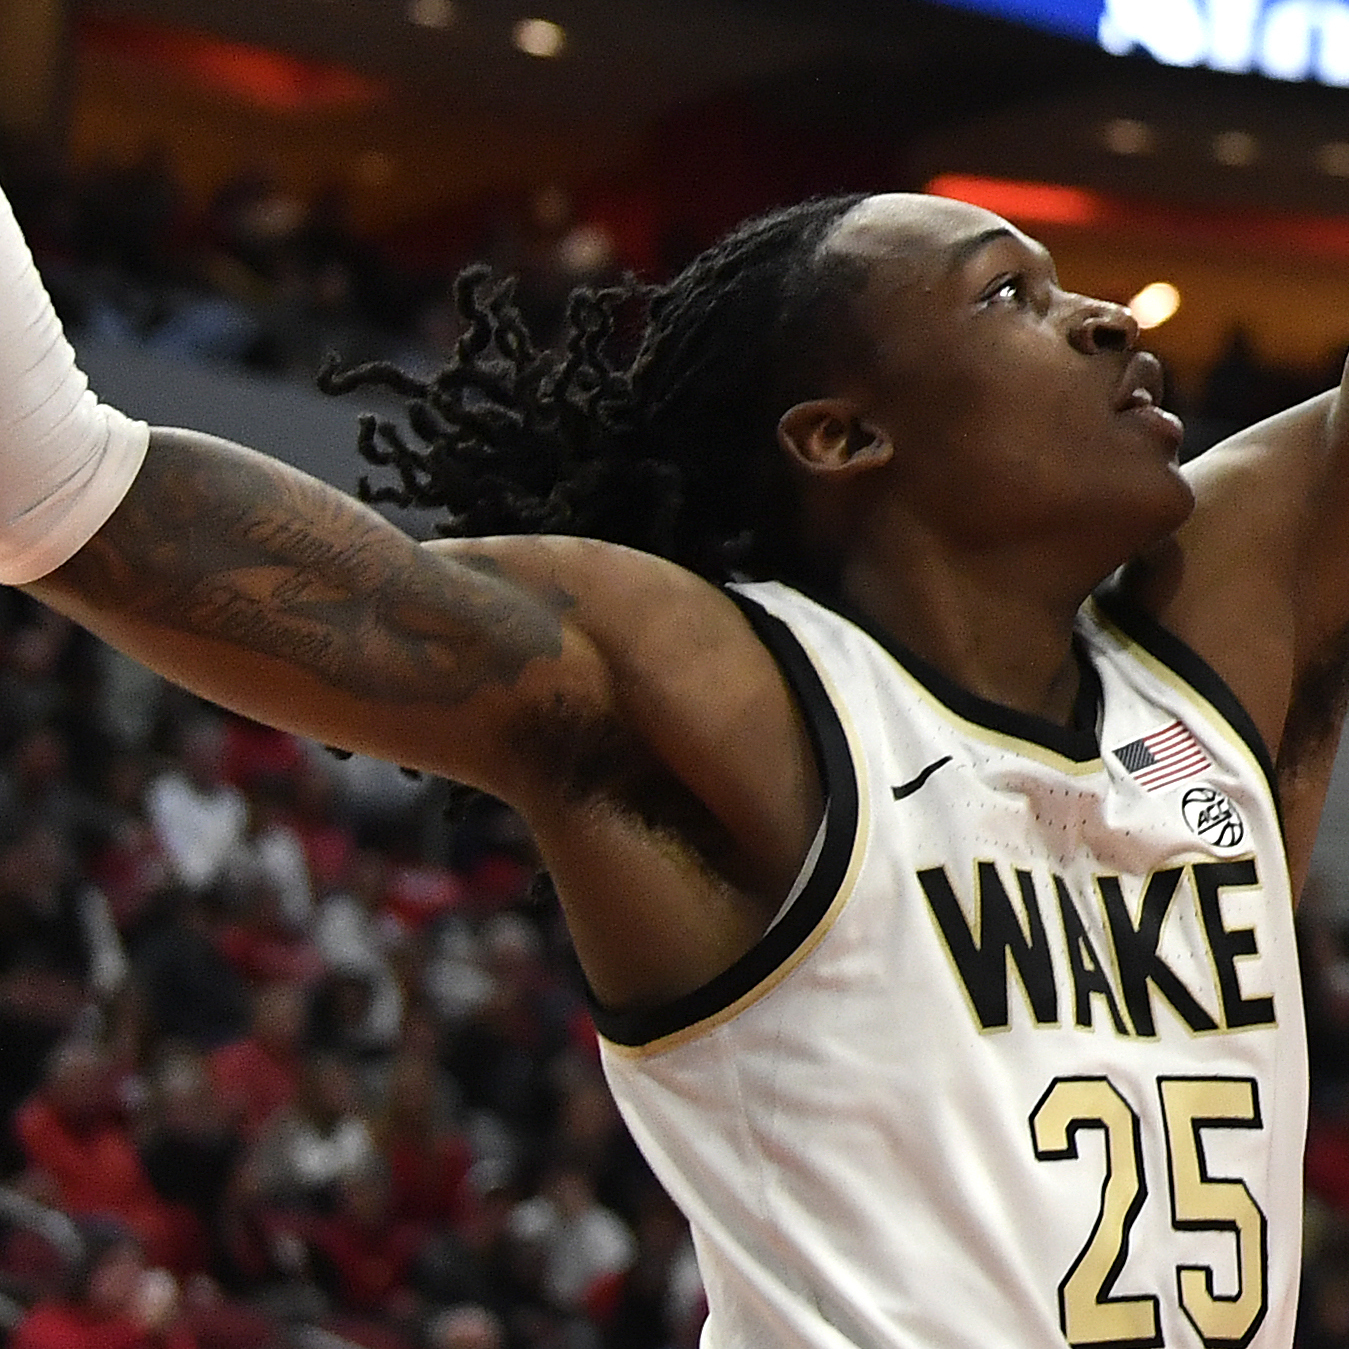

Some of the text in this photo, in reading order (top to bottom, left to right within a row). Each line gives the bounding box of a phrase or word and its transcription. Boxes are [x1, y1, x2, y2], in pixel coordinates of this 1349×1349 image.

[1197, 797, 1232, 830] ACC
[914, 855, 1280, 1042] WAKE
[1028, 1075, 1268, 1349] 25
